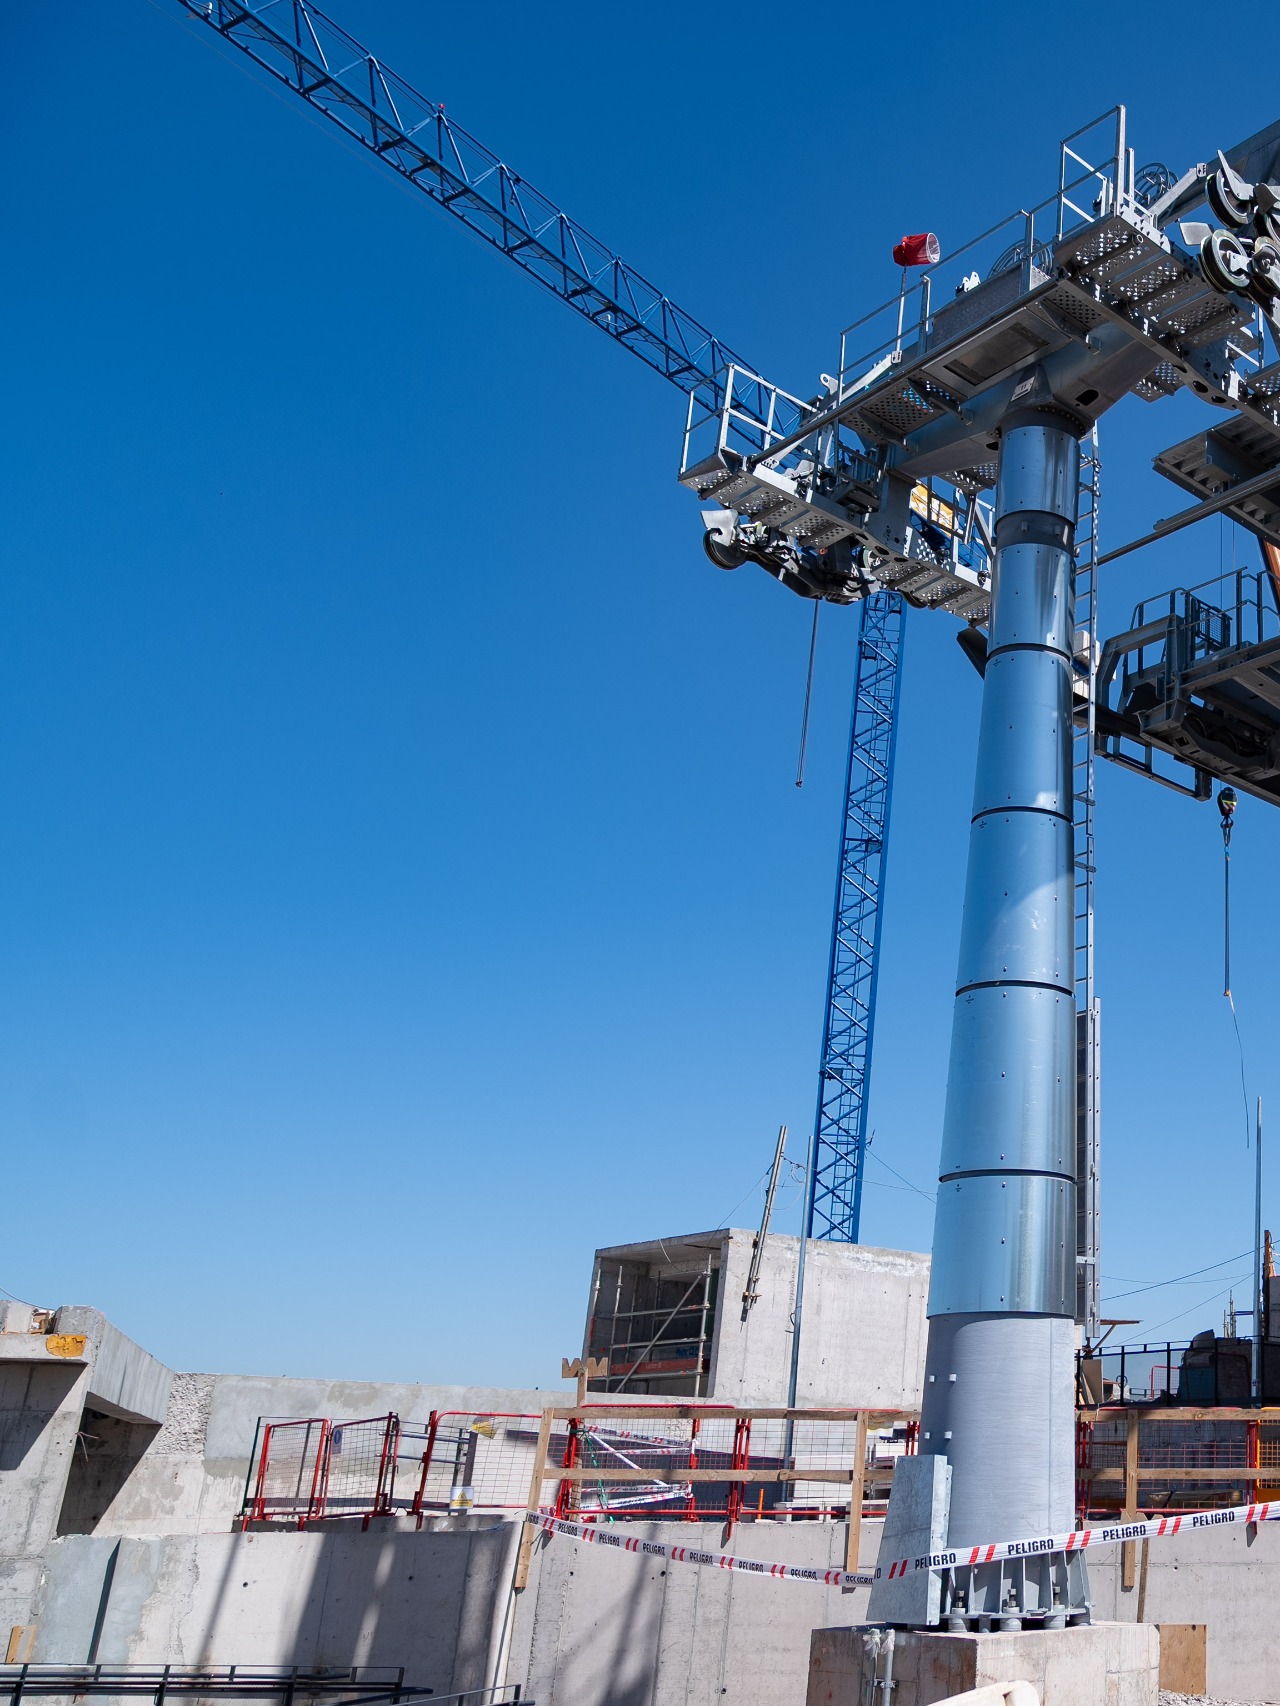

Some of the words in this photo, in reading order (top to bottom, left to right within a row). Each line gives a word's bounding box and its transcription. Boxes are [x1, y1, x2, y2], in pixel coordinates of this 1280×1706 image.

[689, 1552, 714, 1565] PELIGRO
[915, 1552, 956, 1570] PELIGRO
[1008, 1538, 1054, 1555] PELIGRO
[1102, 1524, 1146, 1541] PELIGRO
[1192, 1511, 1235, 1527] PELIGRO
